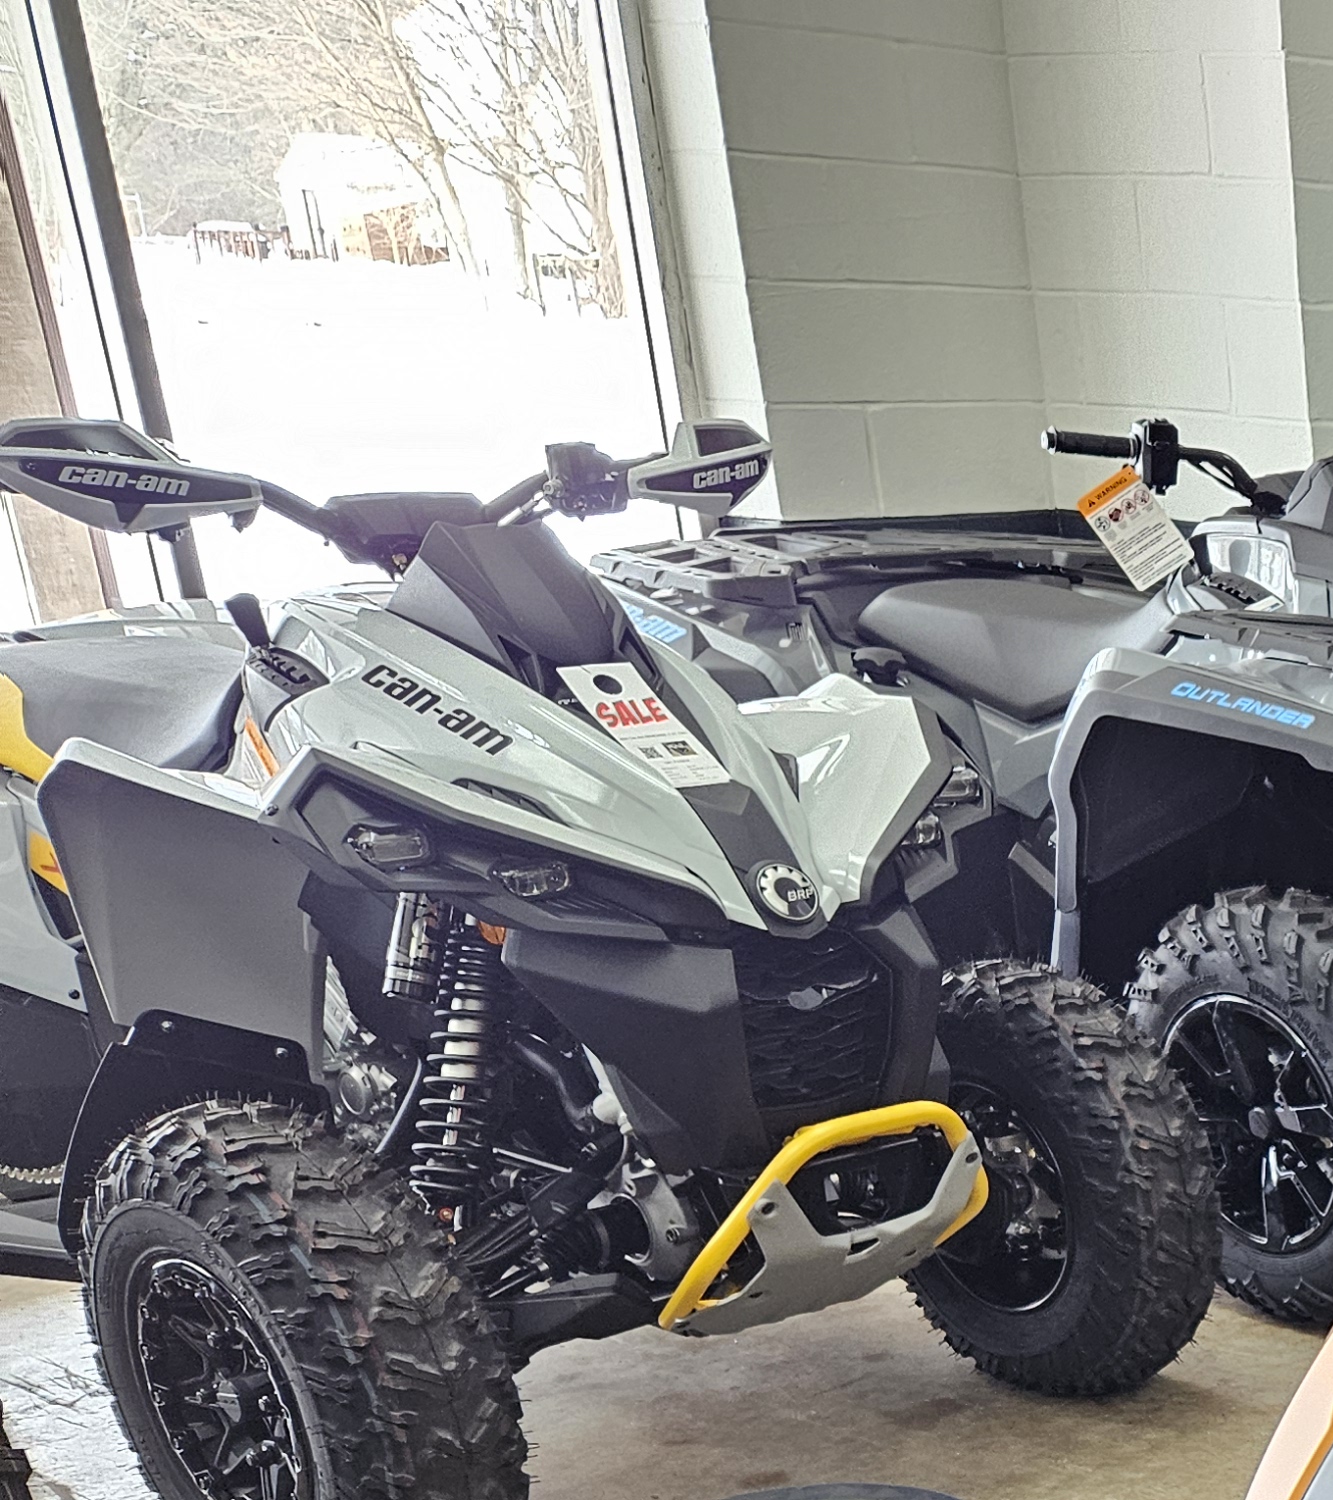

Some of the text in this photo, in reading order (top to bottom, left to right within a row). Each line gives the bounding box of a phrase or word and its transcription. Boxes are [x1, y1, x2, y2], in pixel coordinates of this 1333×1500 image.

[58, 466, 191, 497] can-am
[693, 459, 760, 490] can-am
[1094, 476, 1128, 501] WARNING
[361, 664, 514, 756] can-am
[595, 696, 669, 728] SALE
[1170, 681, 1316, 730] OUTLANDER
[787, 887, 814, 902] BRP
